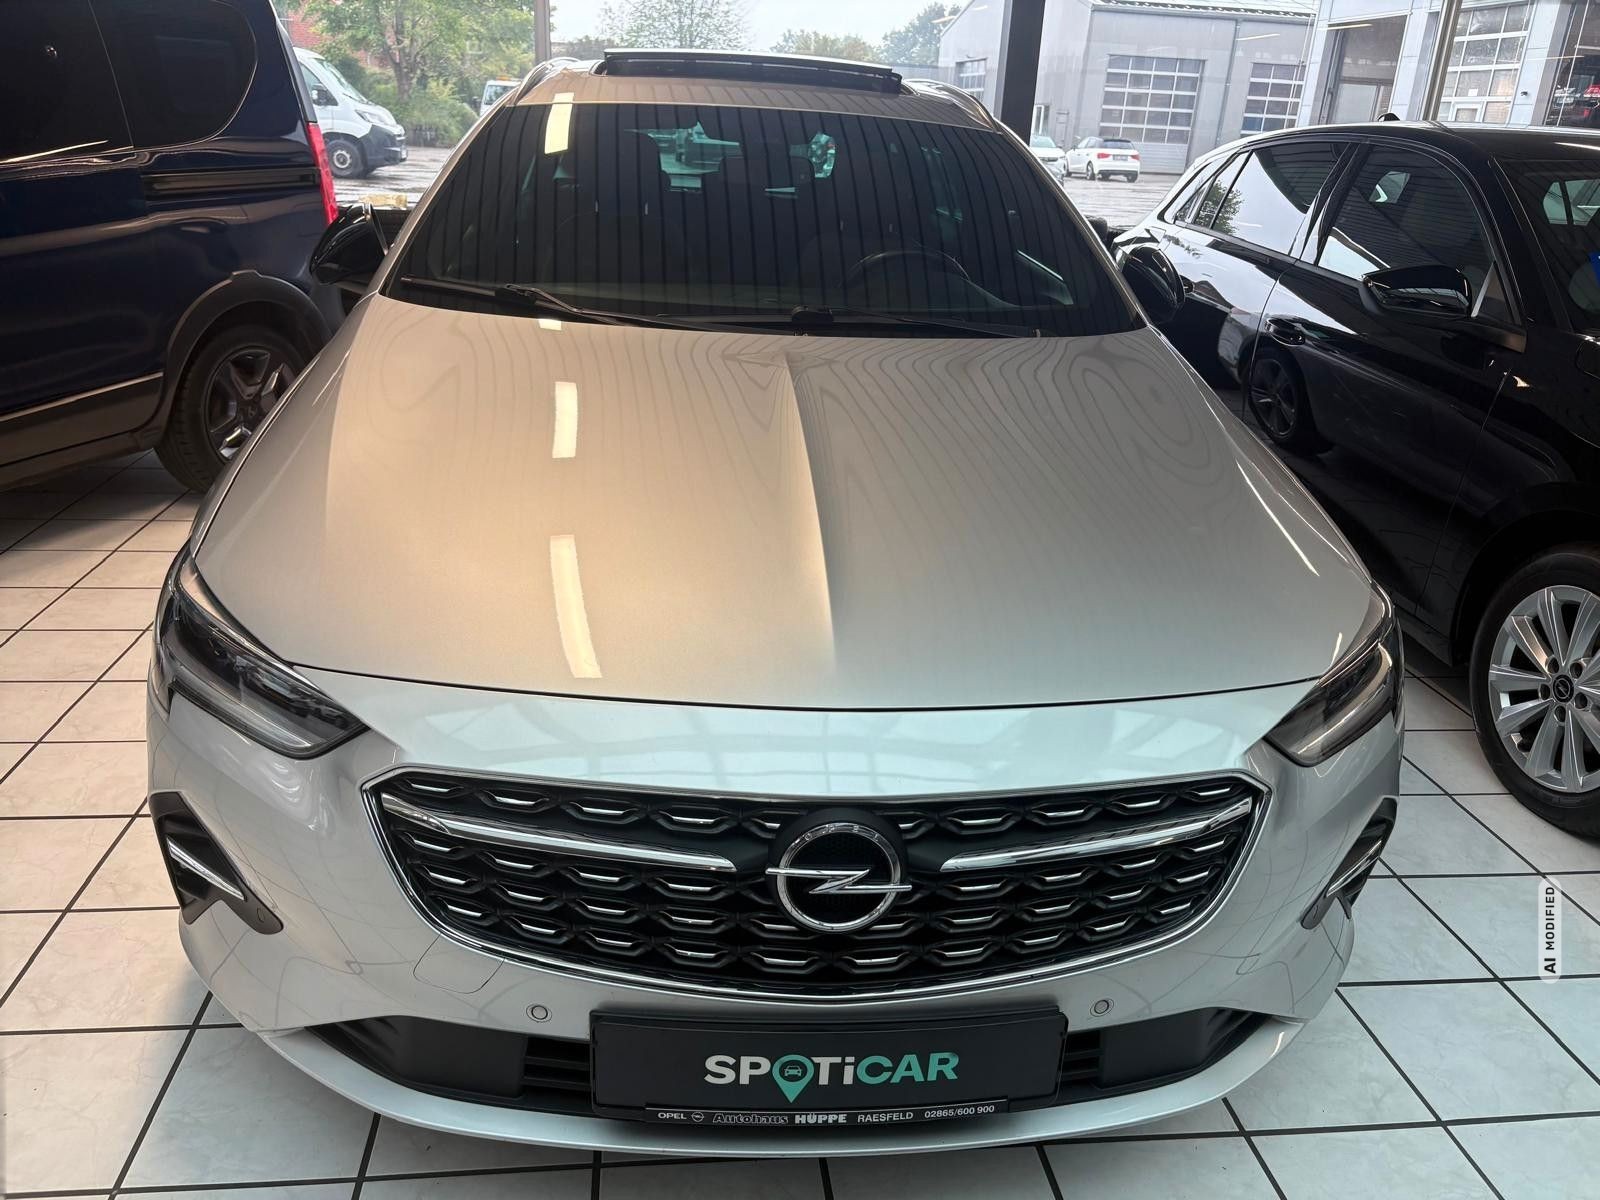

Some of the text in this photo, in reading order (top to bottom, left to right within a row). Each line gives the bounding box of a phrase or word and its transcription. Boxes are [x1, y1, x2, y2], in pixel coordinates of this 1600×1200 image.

[657, 1105, 995, 1125] OPEL Autohaus HÜPPE RAESFELD 02865/600 900
